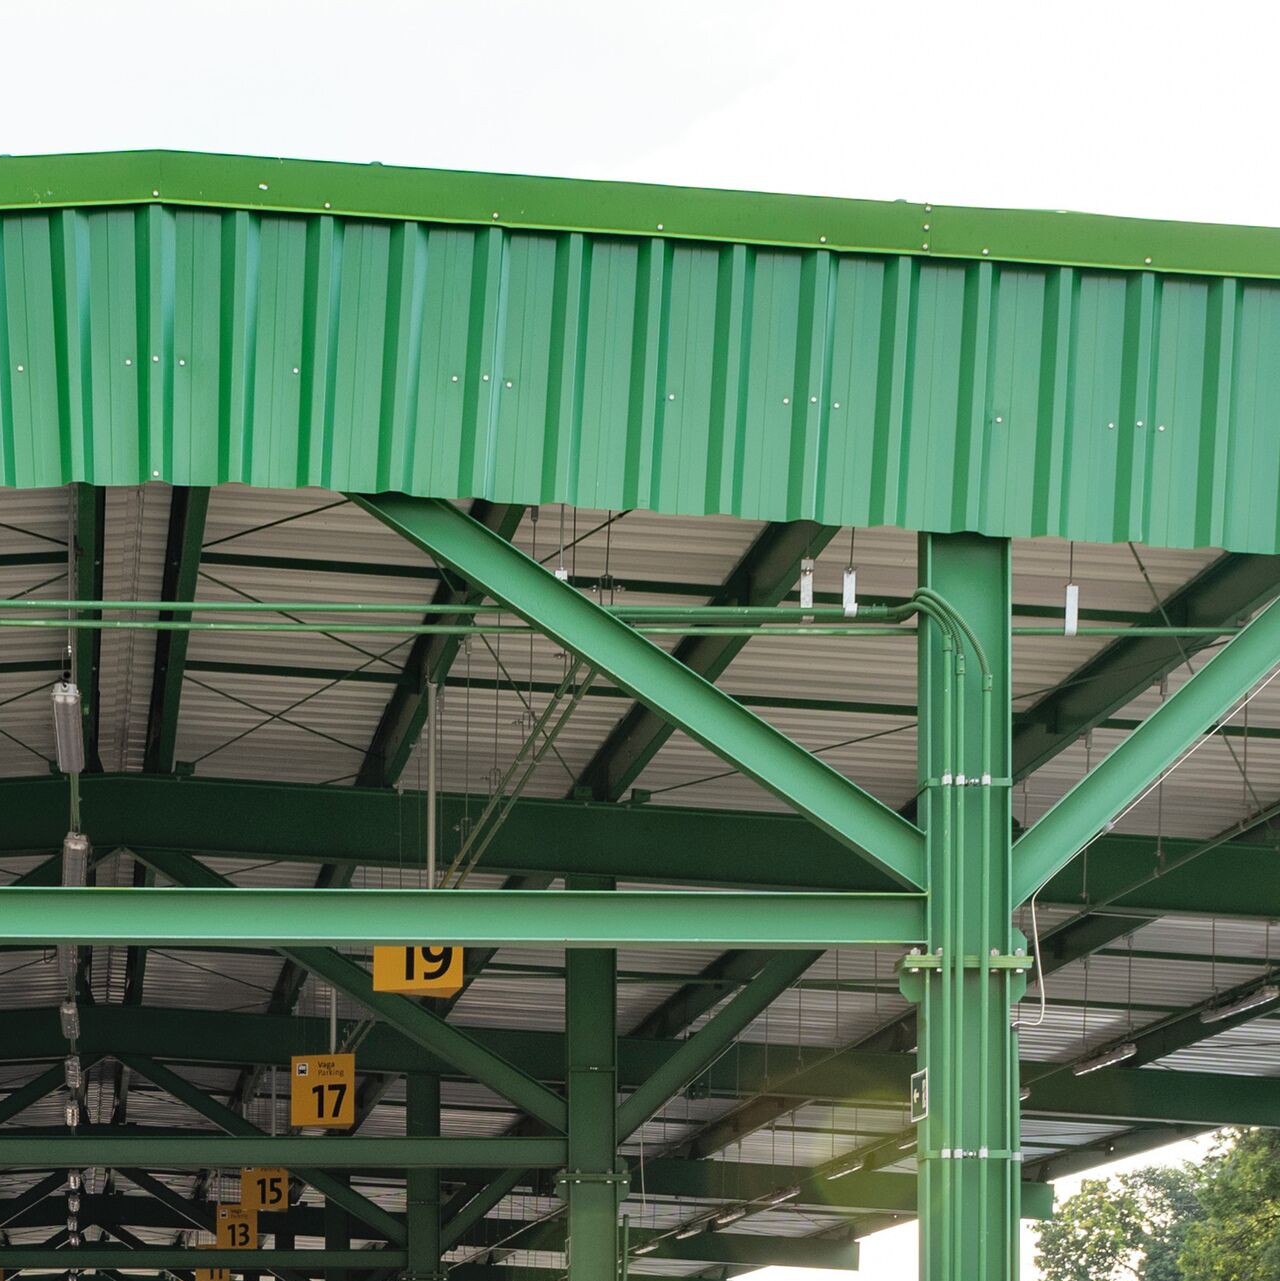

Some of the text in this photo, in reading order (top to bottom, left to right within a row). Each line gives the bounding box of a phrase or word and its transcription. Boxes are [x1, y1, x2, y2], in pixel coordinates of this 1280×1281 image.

[404, 946, 453, 981] 19
[317, 1061, 336, 1071] Vaga
[317, 1068, 345, 1078] Parking
[311, 1083, 347, 1119] 17
[257, 1177, 283, 1204] 15
[227, 1222, 251, 1247] 13
